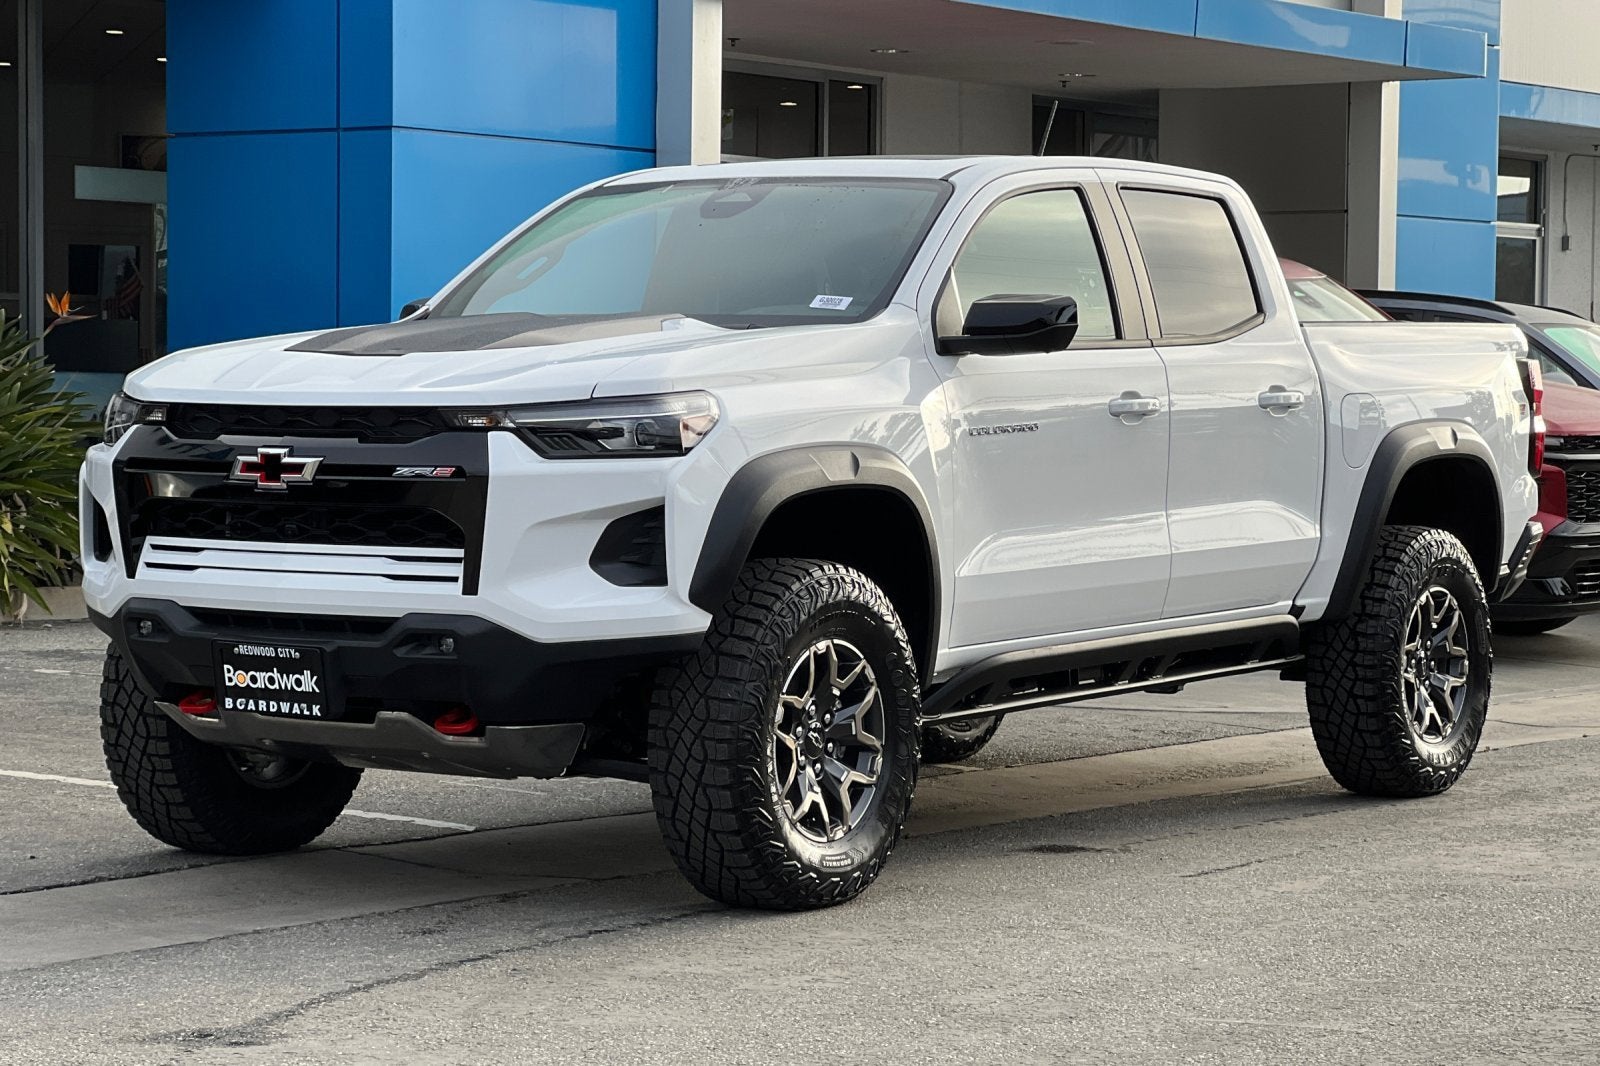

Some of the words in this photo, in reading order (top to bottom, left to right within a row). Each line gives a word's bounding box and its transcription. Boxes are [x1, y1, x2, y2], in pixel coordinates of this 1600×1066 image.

[392, 467, 456, 478] ZR2
[238, 644, 275, 657] REDWOOD
[278, 648, 295, 659] CITY
[223, 664, 320, 693] Boardwalk
[224, 697, 321, 717] BOARDWALK
